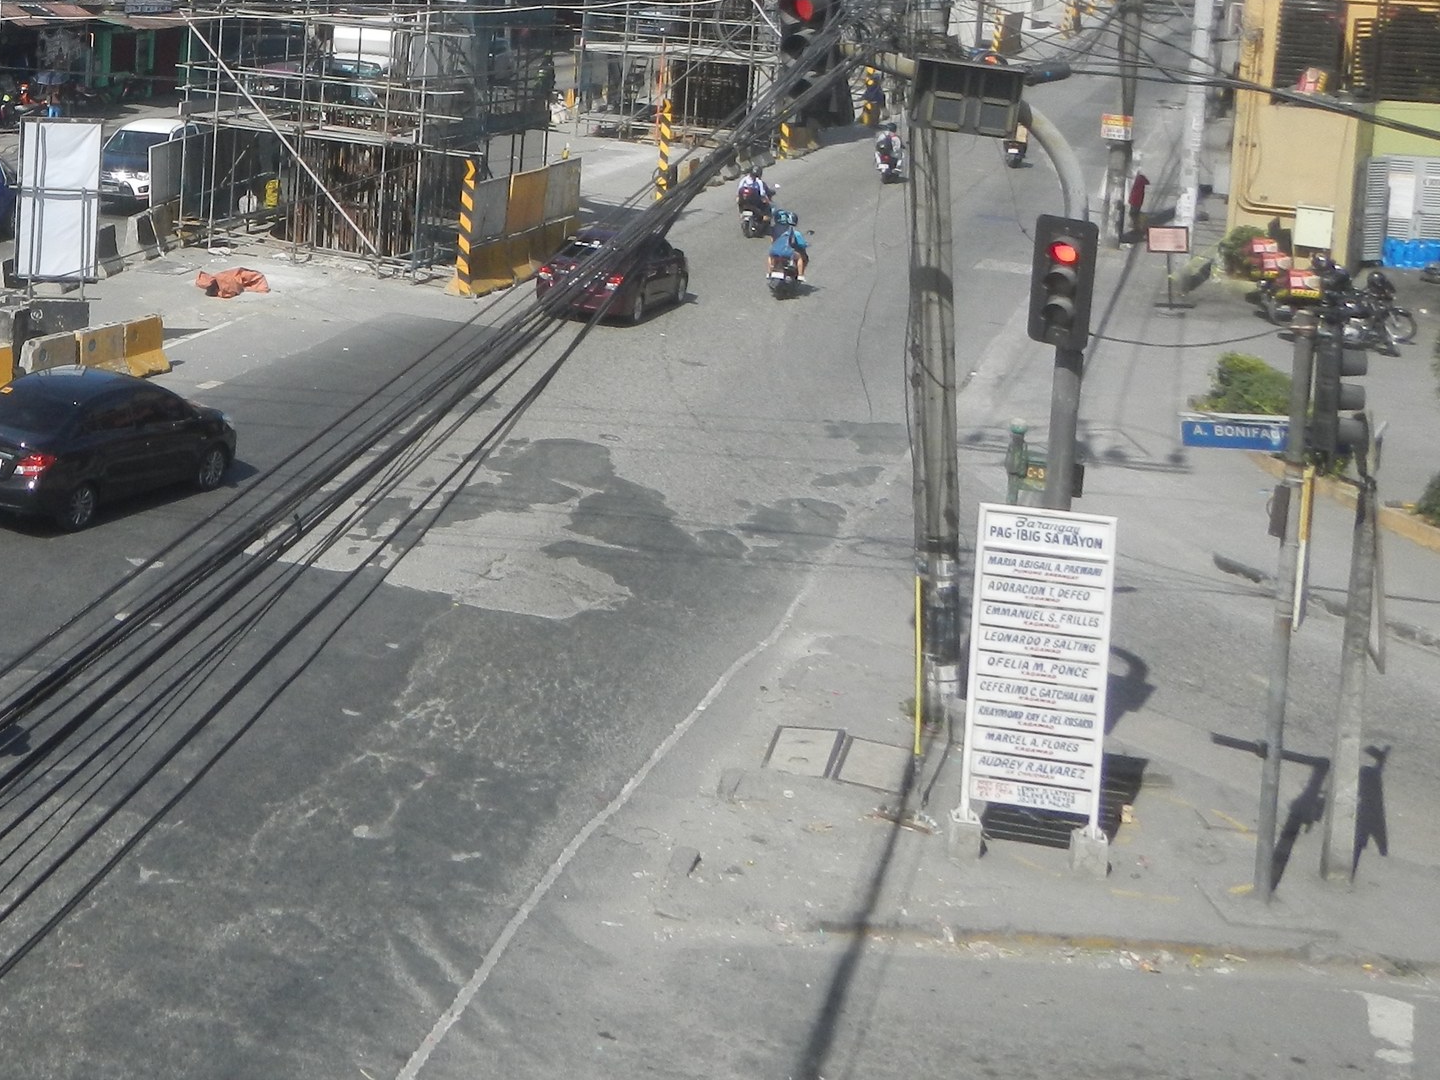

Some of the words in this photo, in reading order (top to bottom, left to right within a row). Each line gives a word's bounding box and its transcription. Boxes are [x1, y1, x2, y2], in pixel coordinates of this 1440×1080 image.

[1193, 425, 1208, 436] A.
[1016, 516, 1081, 535] Barangay
[990, 526, 1040, 542] PAG-IBIG
[1044, 532, 1059, 544] SA
[1062, 534, 1103, 549] NAYON
[988, 556, 1017, 568] MARIA
[1019, 558, 1052, 571] ABIGAIL
[988, 580, 1045, 595] ADORACION
[1058, 588, 1091, 601] DEFEO
[986, 605, 1045, 622] EMMANUEL
[1048, 613, 1057, 623] S.
[1059, 614, 1099, 628] FRILLES
[984, 631, 1041, 646] LEONARDO
[1053, 638, 1096, 653] SALTING
[987, 656, 1029, 670] OFELIA
[1033, 662, 1046, 672] M.
[1050, 664, 1089, 679] PONCE
[979, 680, 1028, 696] CEFERINO
[1039, 688, 1095, 704] GATCHALIAN
[985, 732, 1027, 746] MARCEL
[1041, 739, 1079, 752] FLORES
[978, 755, 1024, 769] AUDREY
[1036, 762, 1086, 779] ALVAREZ
